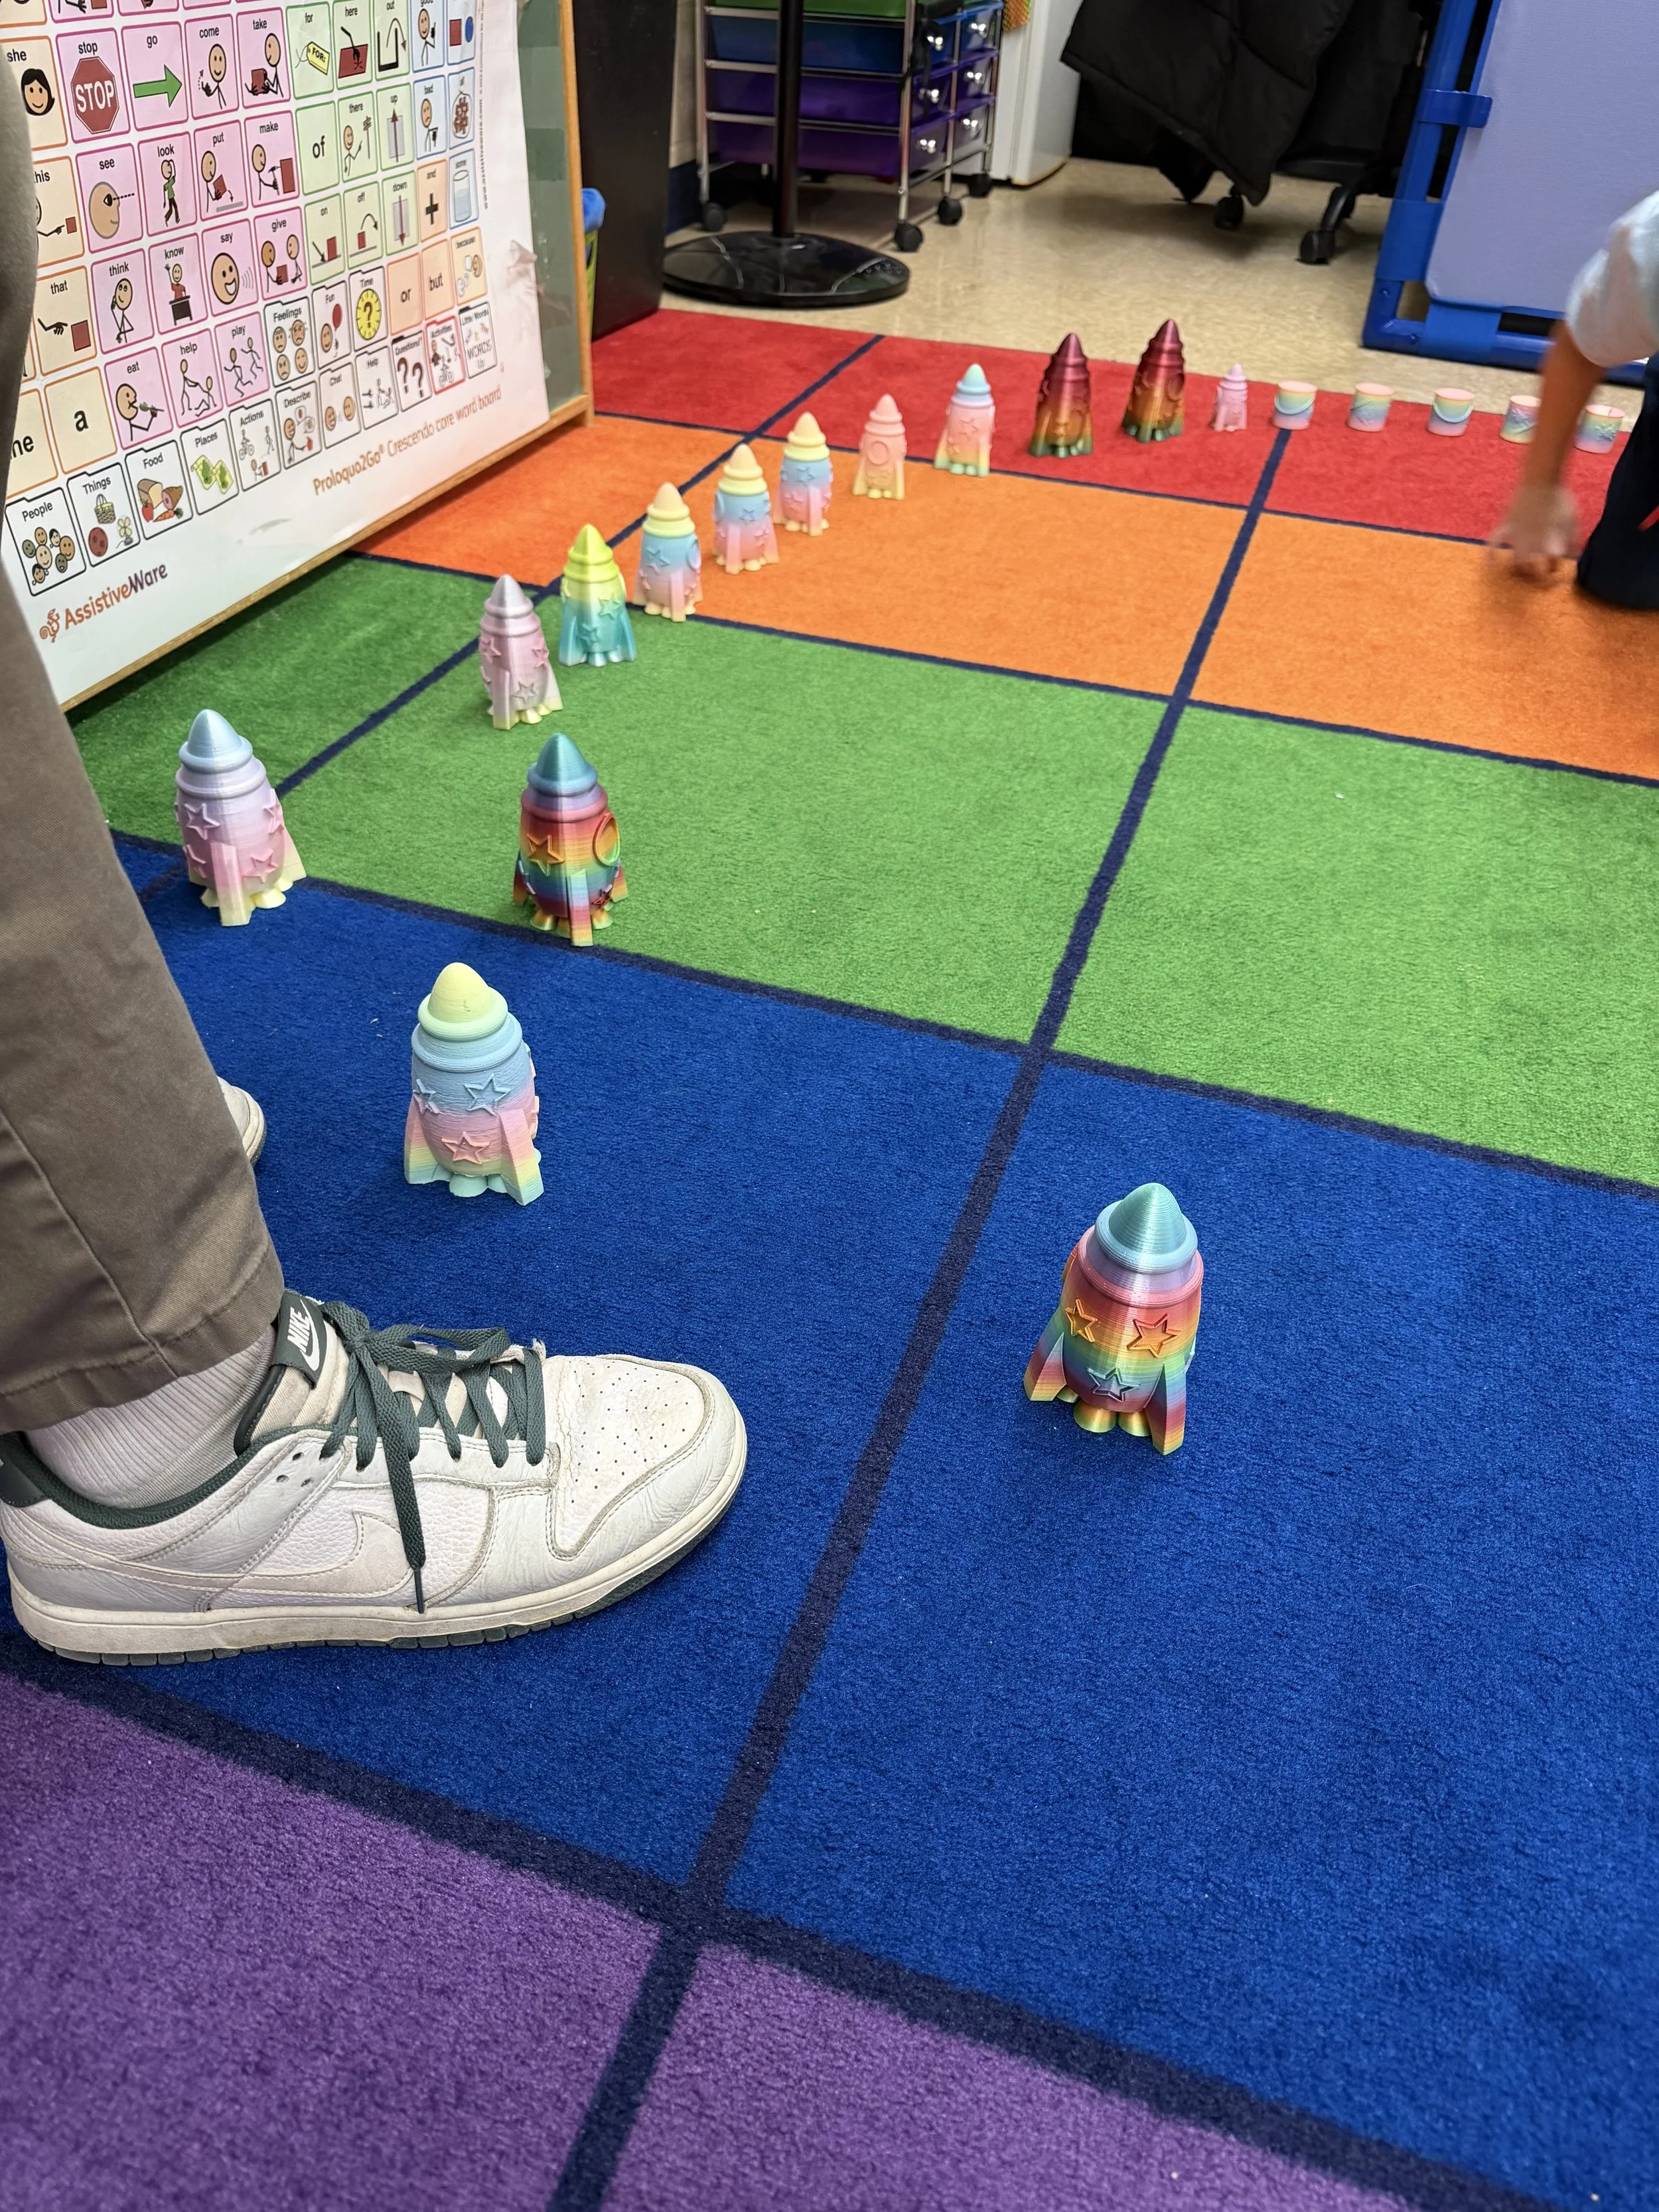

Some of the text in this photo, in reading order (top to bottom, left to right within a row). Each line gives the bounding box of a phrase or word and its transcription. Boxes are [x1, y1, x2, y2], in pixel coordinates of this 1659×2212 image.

[345, 7, 358, 16] here
[386, 1, 395, 10] out
[253, 19, 267, 30] take
[200, 27, 219, 38] come
[78, 42, 98, 55] stop
[147, 36, 157, 48] go
[7, 49, 27, 62] she
[425, 84, 433, 94] bad
[75, 80, 114, 112] STOP
[391, 95, 397, 104] up
[349, 104, 363, 113] there
[259, 122, 278, 133] make
[213, 133, 224, 146] put
[157, 144, 175, 157] look
[312, 135, 325, 159] of
[100, 159, 115, 170] see
[34, 170, 50, 183] his
[394, 182, 407, 192] down
[272, 219, 287, 232] give
[220, 233, 234, 245] say
[165, 247, 184, 259] know
[109, 263, 129, 277] think
[50, 280, 68, 294] that
[360, 279, 373, 288] Time
[429, 273, 443, 291] but
[325, 294, 335, 304] Fun
[401, 289, 411, 303] or
[273, 307, 302, 323] Feelings
[232, 326, 246, 338] play
[180, 342, 197, 355] help
[127, 362, 139, 374] eat
[367, 358, 379, 368] Help
[284, 390, 311, 408] Describe
[74, 411, 88, 431] a
[240, 409, 264, 427] Actions
[388, 421, 435, 457] Crescendo
[436, 413, 455, 432] core
[456, 397, 478, 421] word
[478, 383, 502, 411] board
[195, 431, 218, 448] Places
[143, 453, 163, 469] Food
[82, 476, 111, 495] Things
[22, 501, 53, 522] People
[64, 564, 168, 630] AssistiveWare
[287, 1306, 310, 1354] NIKE
